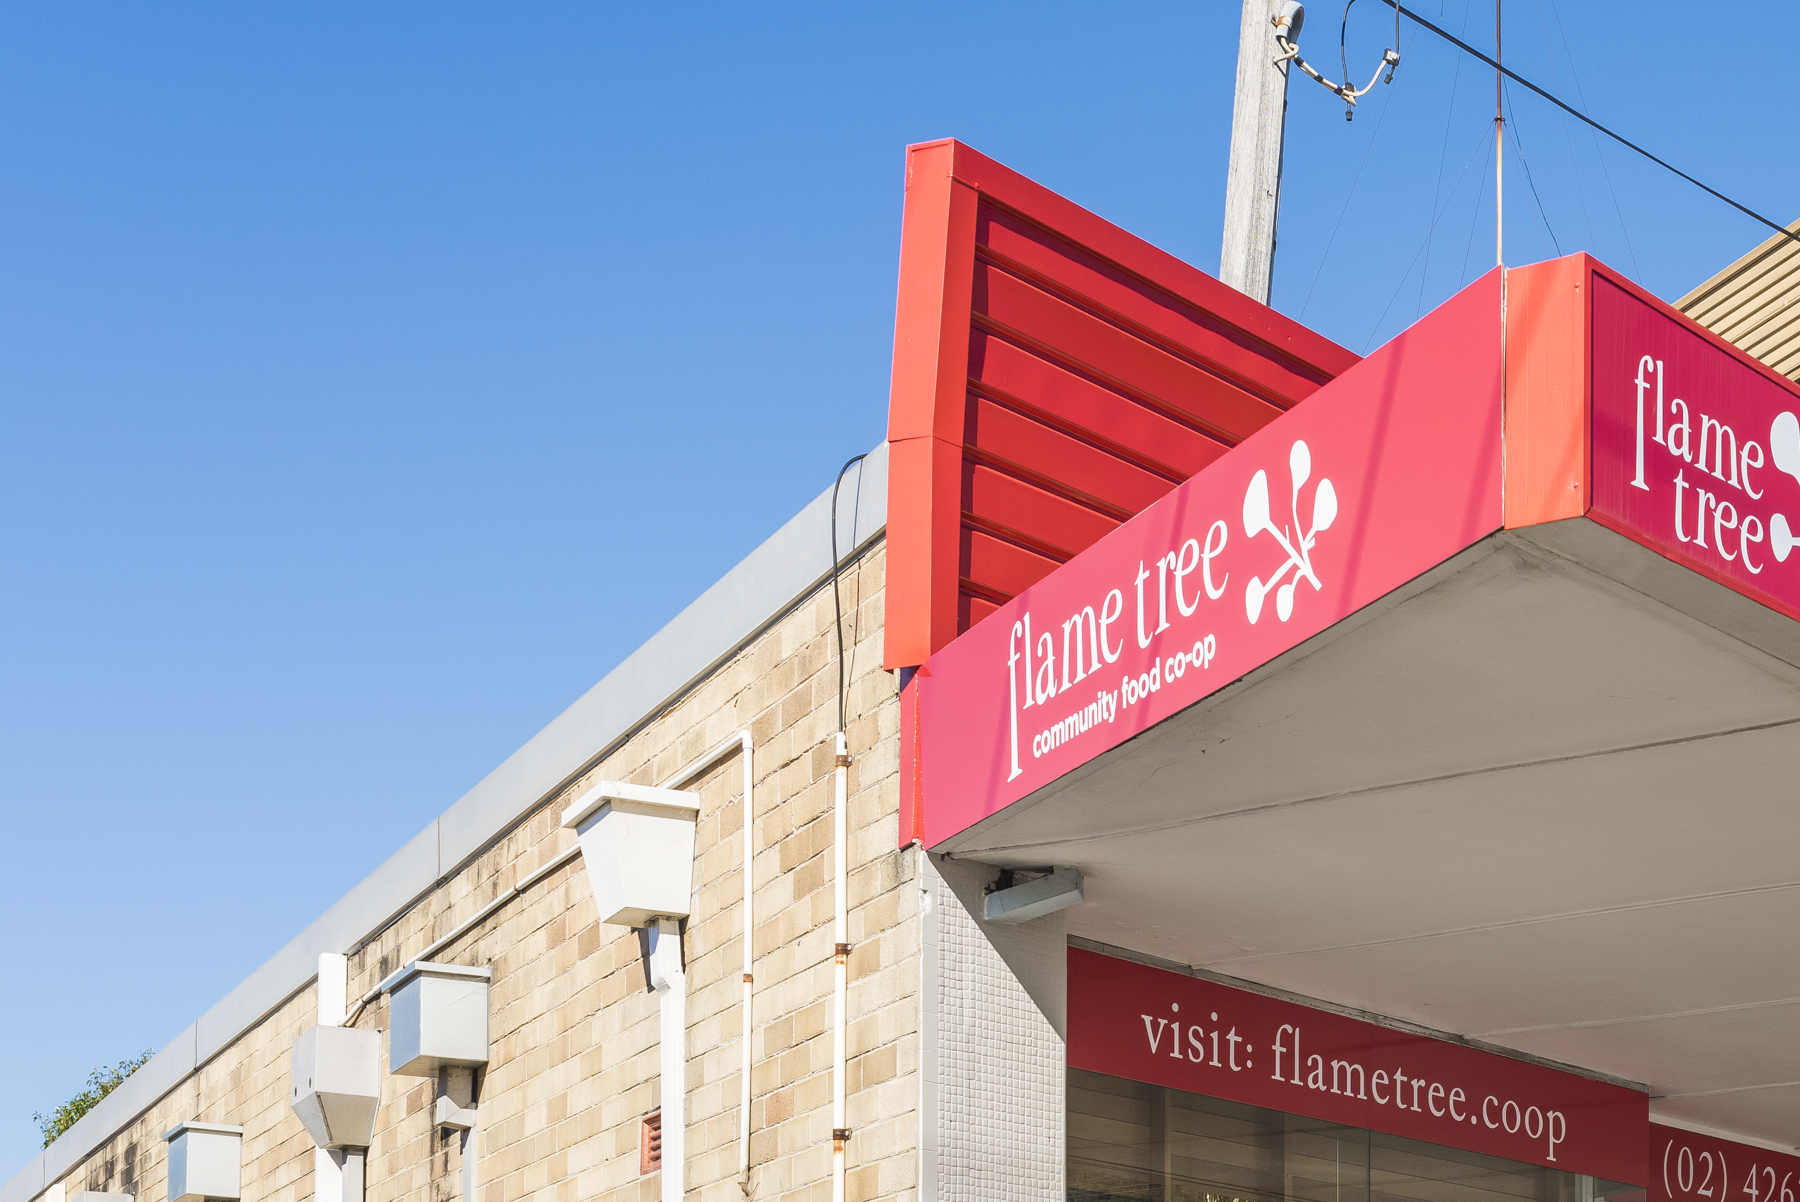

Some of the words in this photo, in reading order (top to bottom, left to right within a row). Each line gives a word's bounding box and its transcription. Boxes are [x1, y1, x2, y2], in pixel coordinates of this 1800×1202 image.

[1630, 355, 1765, 501] flame
[1673, 468, 1764, 574] tree
[1007, 612, 1123, 783] flame
[1134, 519, 1229, 650] tree
[1032, 690, 1118, 759] community
[1121, 657, 1161, 706] food
[1165, 634, 1217, 684] co-op
[1140, 1002, 1254, 1071] visit:
[1271, 1023, 1568, 1162] flametree.coop
